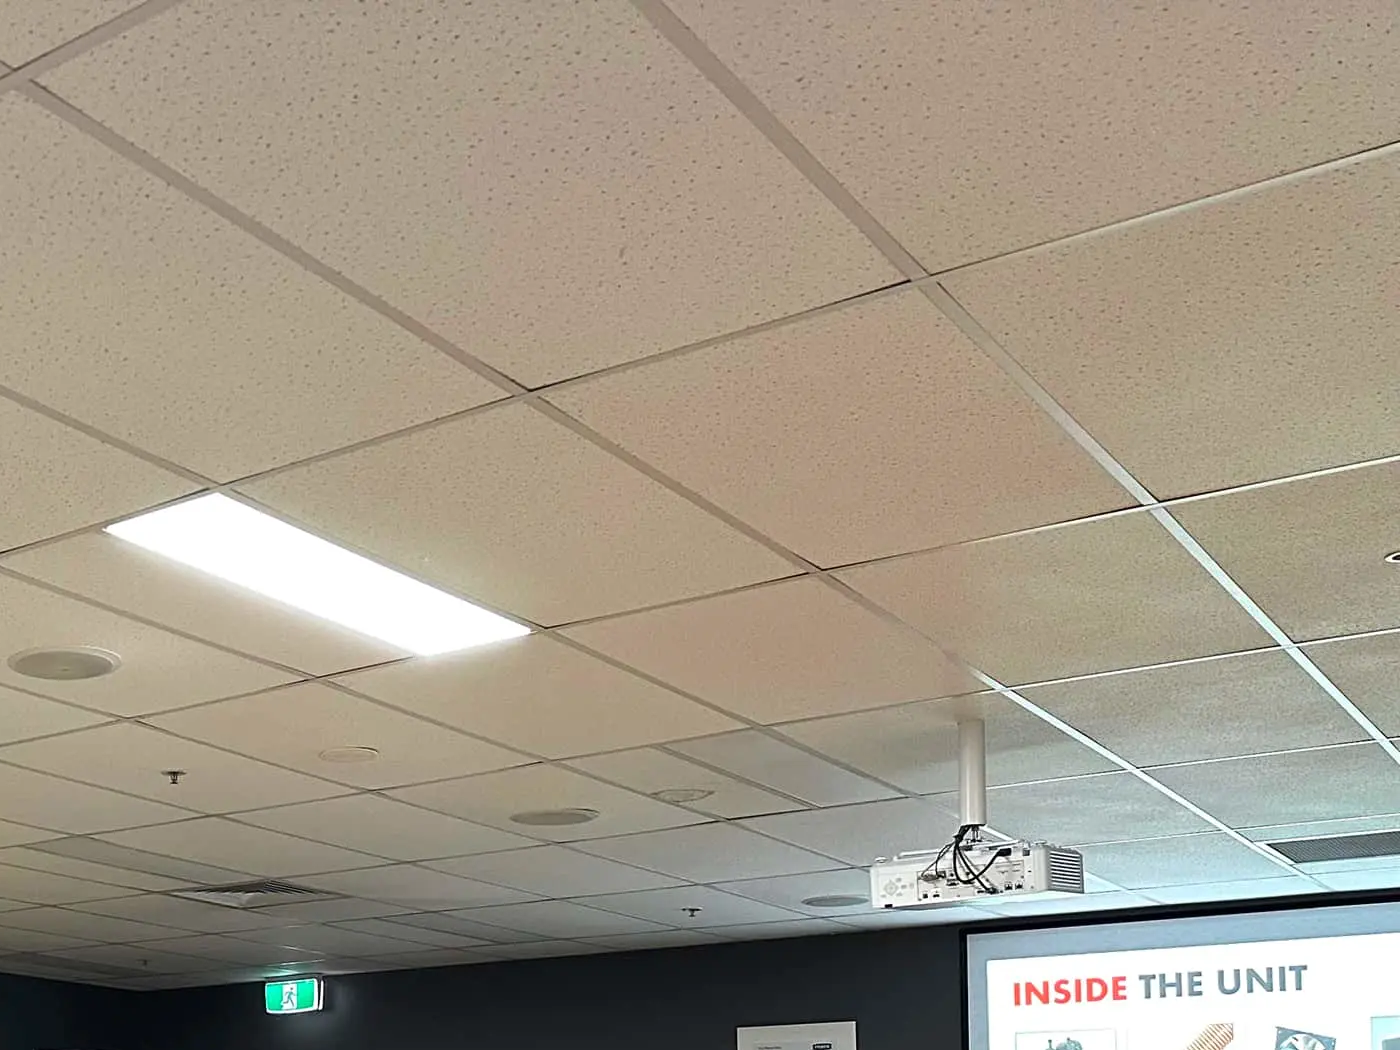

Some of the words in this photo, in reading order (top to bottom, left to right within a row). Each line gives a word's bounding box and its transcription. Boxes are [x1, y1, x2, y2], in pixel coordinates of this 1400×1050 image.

[1013, 975, 1128, 1007] INSIDE
[1138, 971, 1203, 999] THE
[1217, 964, 1309, 996] UNIT
